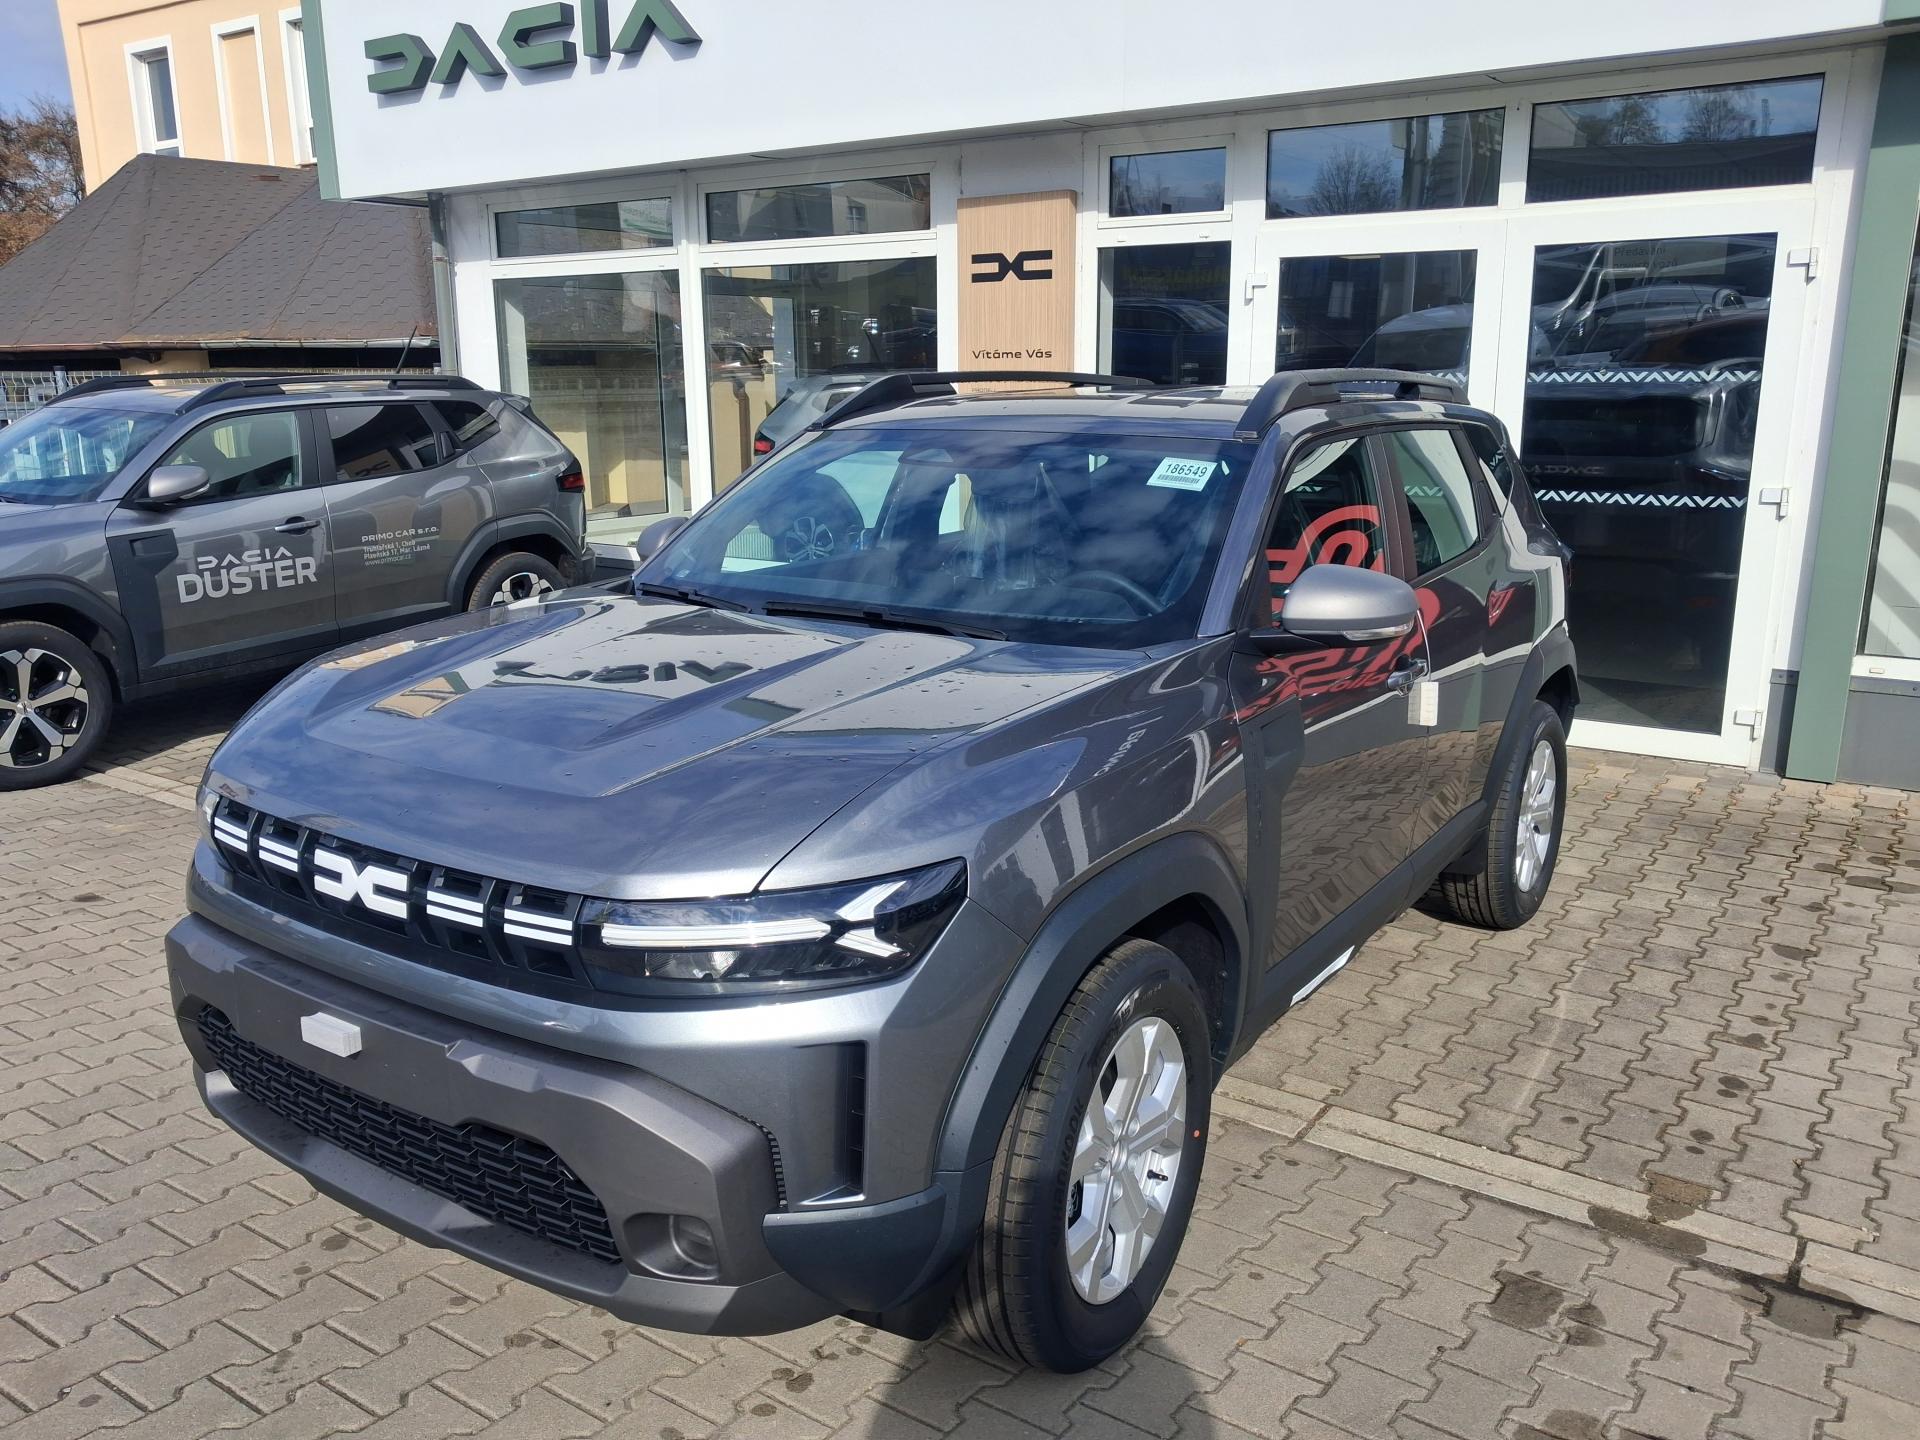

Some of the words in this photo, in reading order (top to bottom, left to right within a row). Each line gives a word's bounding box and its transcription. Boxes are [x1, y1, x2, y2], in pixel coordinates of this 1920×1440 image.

[364, 0, 703, 94] DACIA
[971, 349, 1022, 360] Vítáme
[1025, 348, 1053, 359] Vás
[1165, 463, 1208, 478] 186549
[361, 532, 394, 543] PRIMO
[395, 528, 416, 538] CAR
[417, 526, 440, 535] s.r.o.
[197, 546, 293, 570] DACIA
[176, 556, 318, 604] DUSTER
